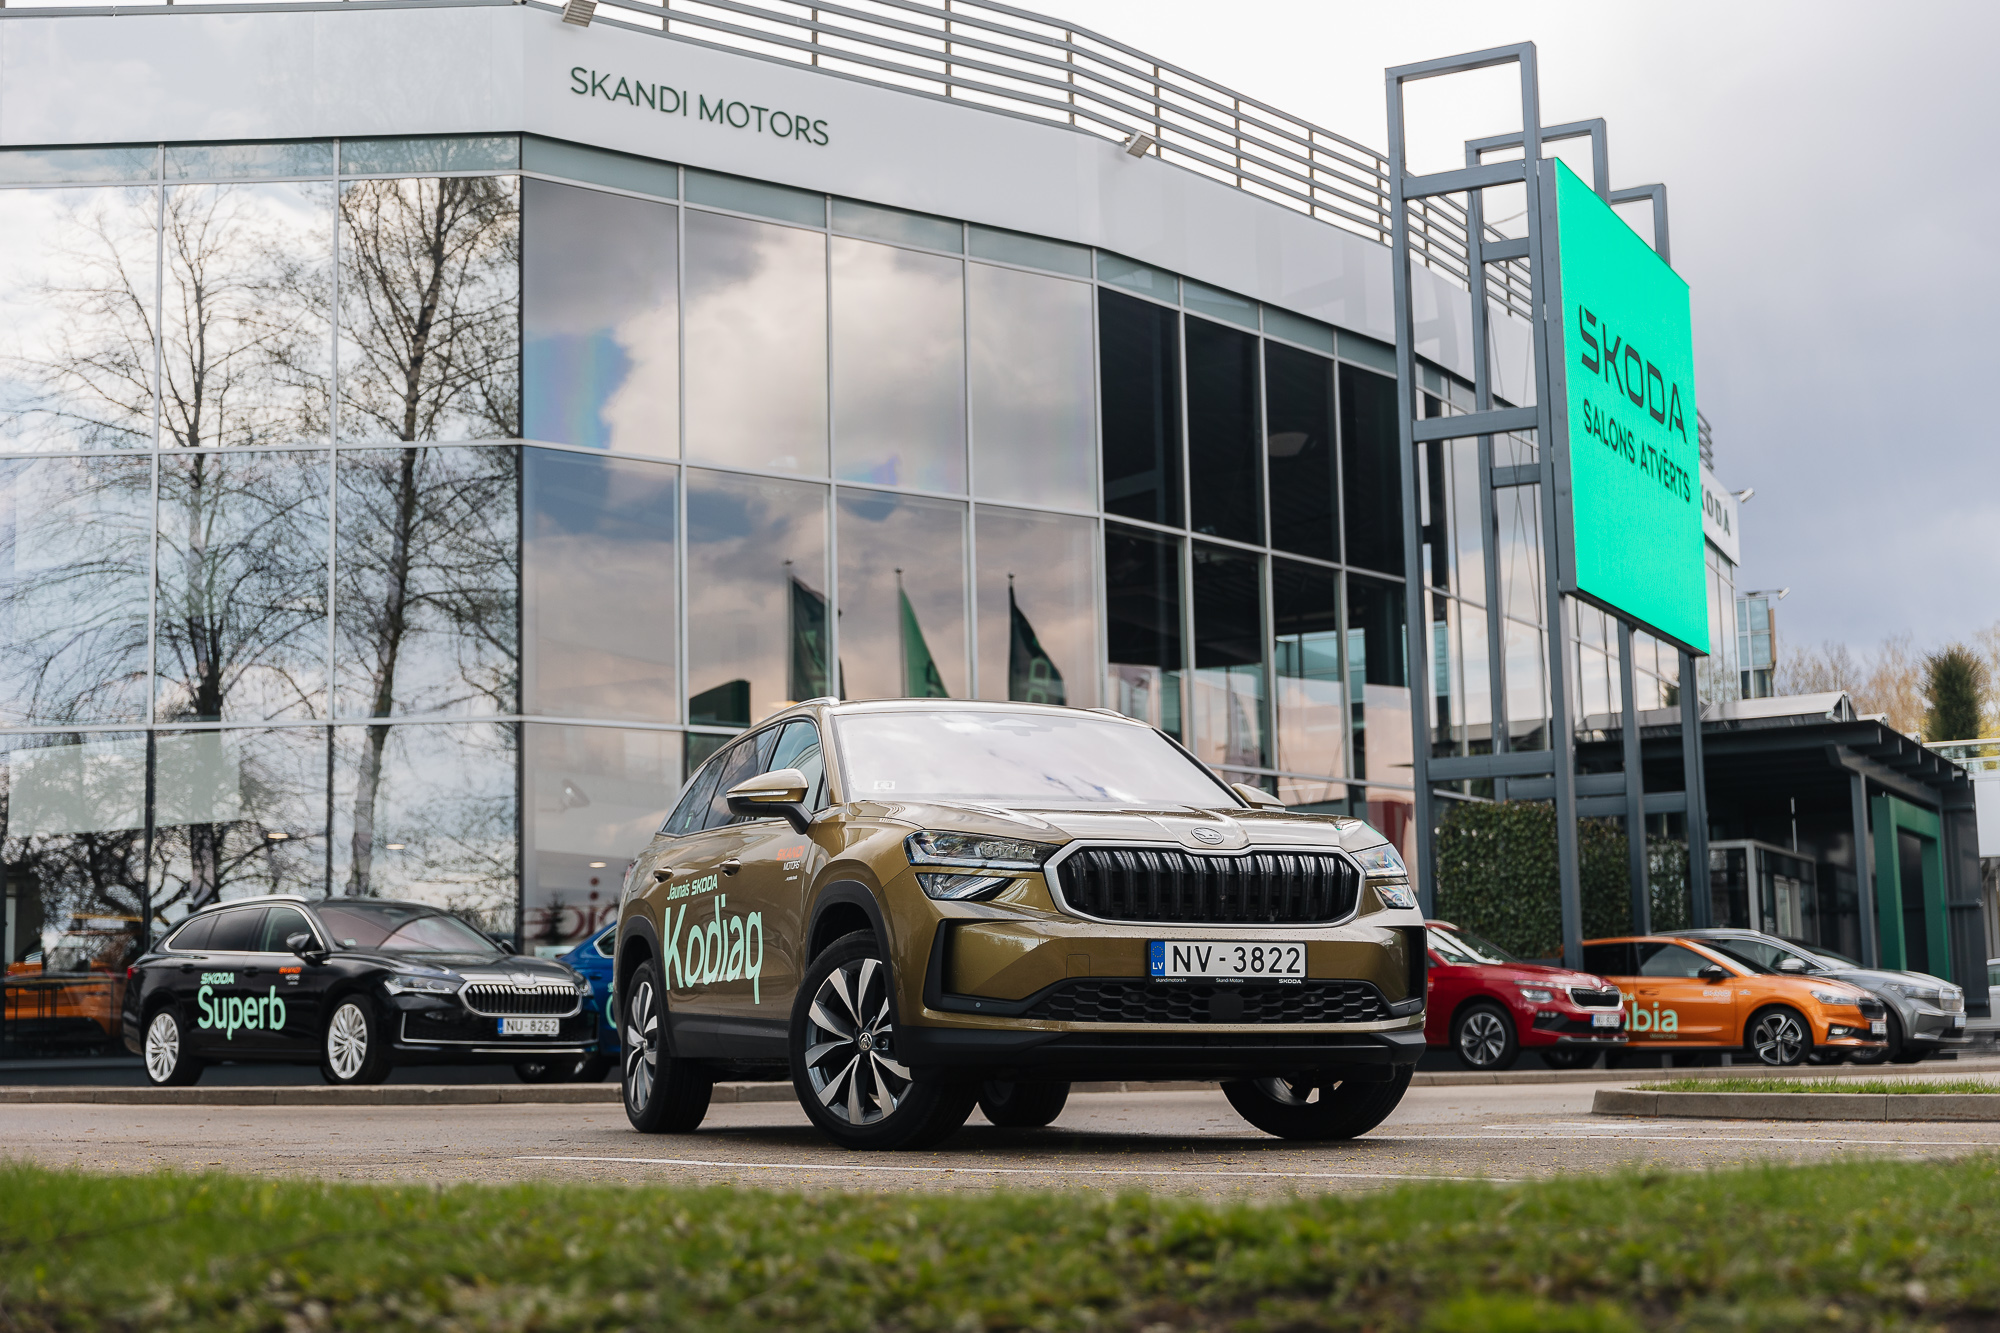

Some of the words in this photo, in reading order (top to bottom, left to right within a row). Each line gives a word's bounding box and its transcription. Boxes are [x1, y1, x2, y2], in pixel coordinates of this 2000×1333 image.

[571, 66, 687, 117] SKANDI
[699, 94, 829, 146] MOTORS
[1583, 398, 1635, 464] SALONS
[1701, 484, 1731, 537] ODA
[666, 879, 690, 901] Jaunais
[782, 860, 801, 871] MOTORS
[663, 893, 764, 1005] Kodiaq
[1152, 962, 1164, 970] LV
[197, 984, 287, 1041] Superb
